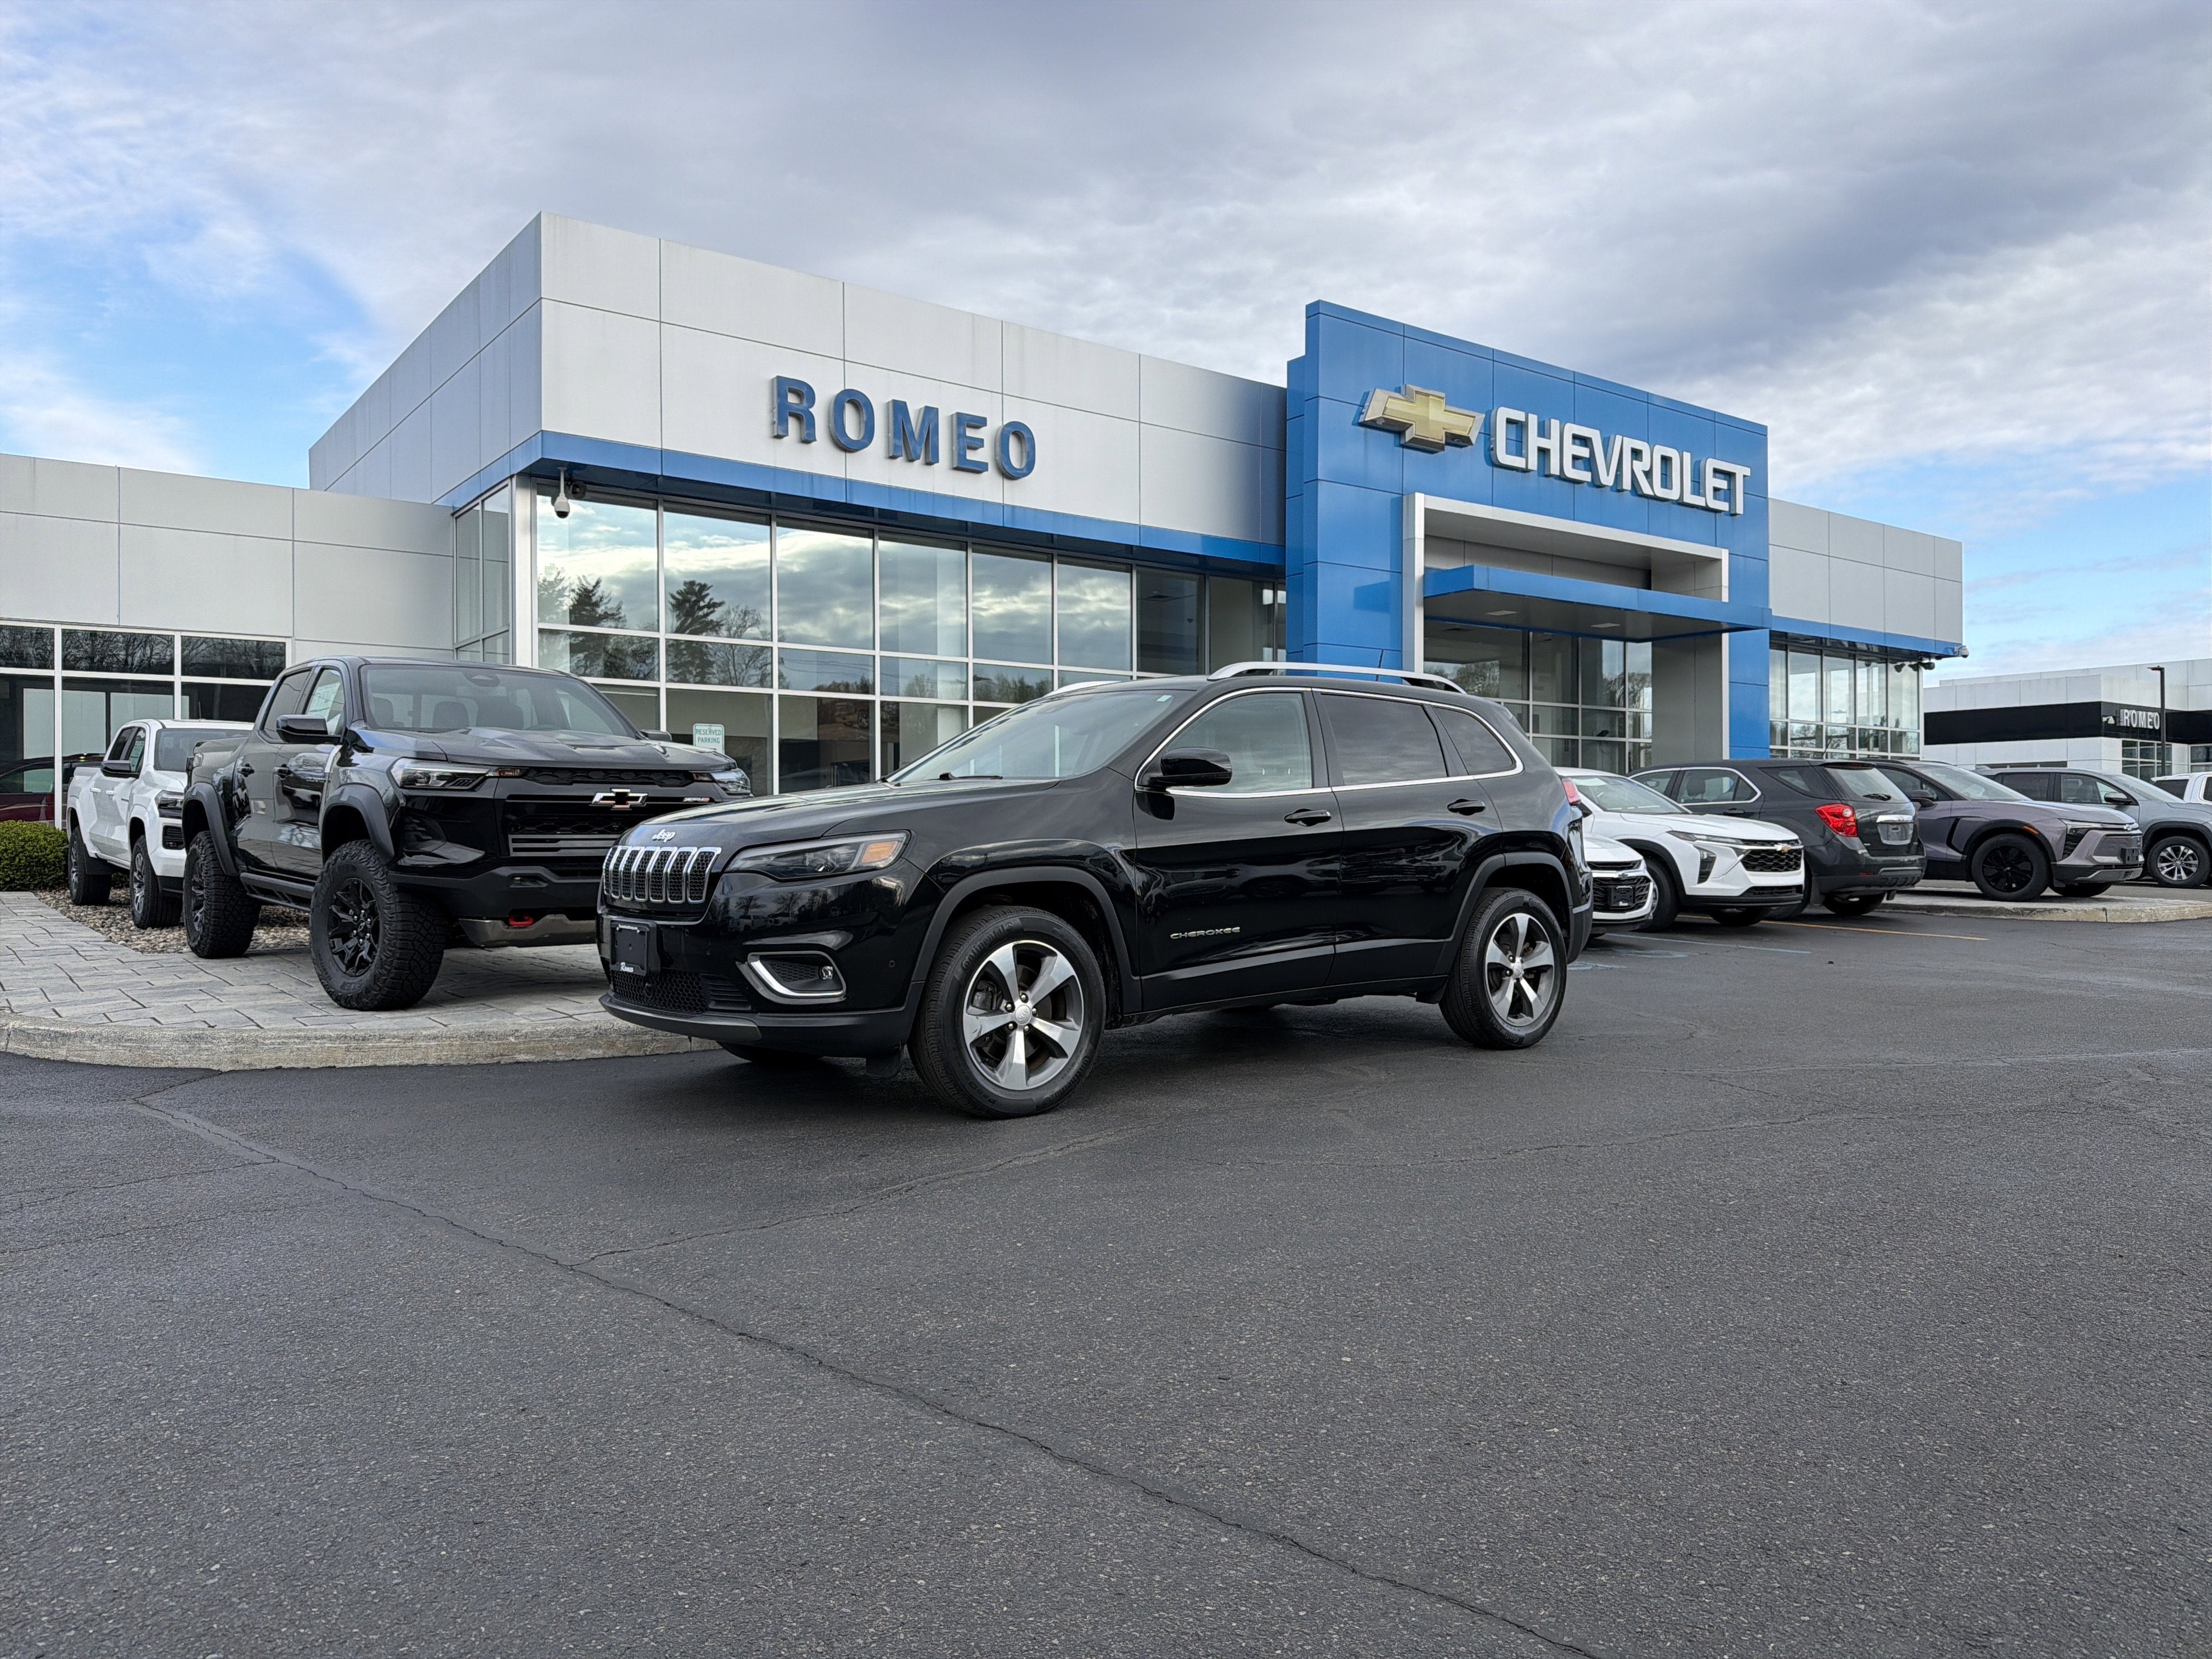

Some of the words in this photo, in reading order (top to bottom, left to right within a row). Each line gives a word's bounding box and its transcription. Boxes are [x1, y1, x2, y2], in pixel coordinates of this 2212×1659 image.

[772, 375, 1036, 479] ROMEO
[1490, 407, 1751, 516] CHEVROLET
[2120, 709, 2160, 730] ROMEO
[651, 829, 676, 843] Jeep
[1170, 927, 1240, 939] CHEROKEE
